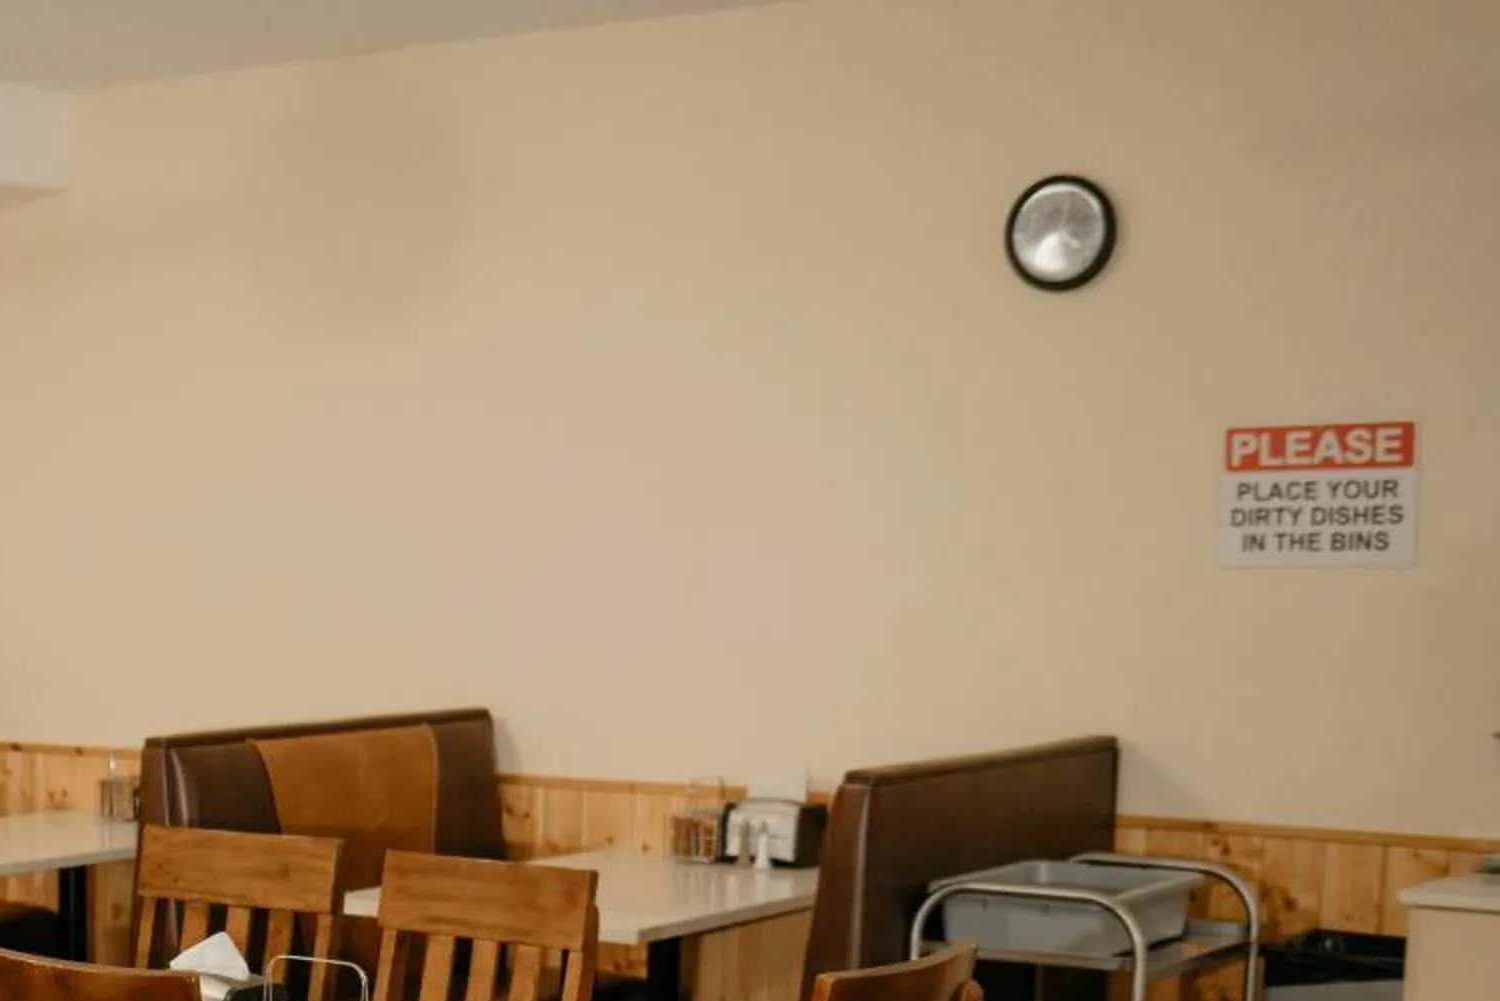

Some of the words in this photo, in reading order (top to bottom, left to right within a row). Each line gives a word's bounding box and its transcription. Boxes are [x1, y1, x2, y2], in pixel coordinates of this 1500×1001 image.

[1230, 427, 1404, 467] PLEASE
[1236, 480, 1318, 502] PLACE
[1327, 479, 1399, 500] YOUR
[1230, 506, 1303, 527] DIRTY
[1310, 504, 1404, 526] DISHES
[1242, 533, 1266, 552] IN
[1274, 532, 1321, 552] THE
[1330, 531, 1391, 552] BINS
